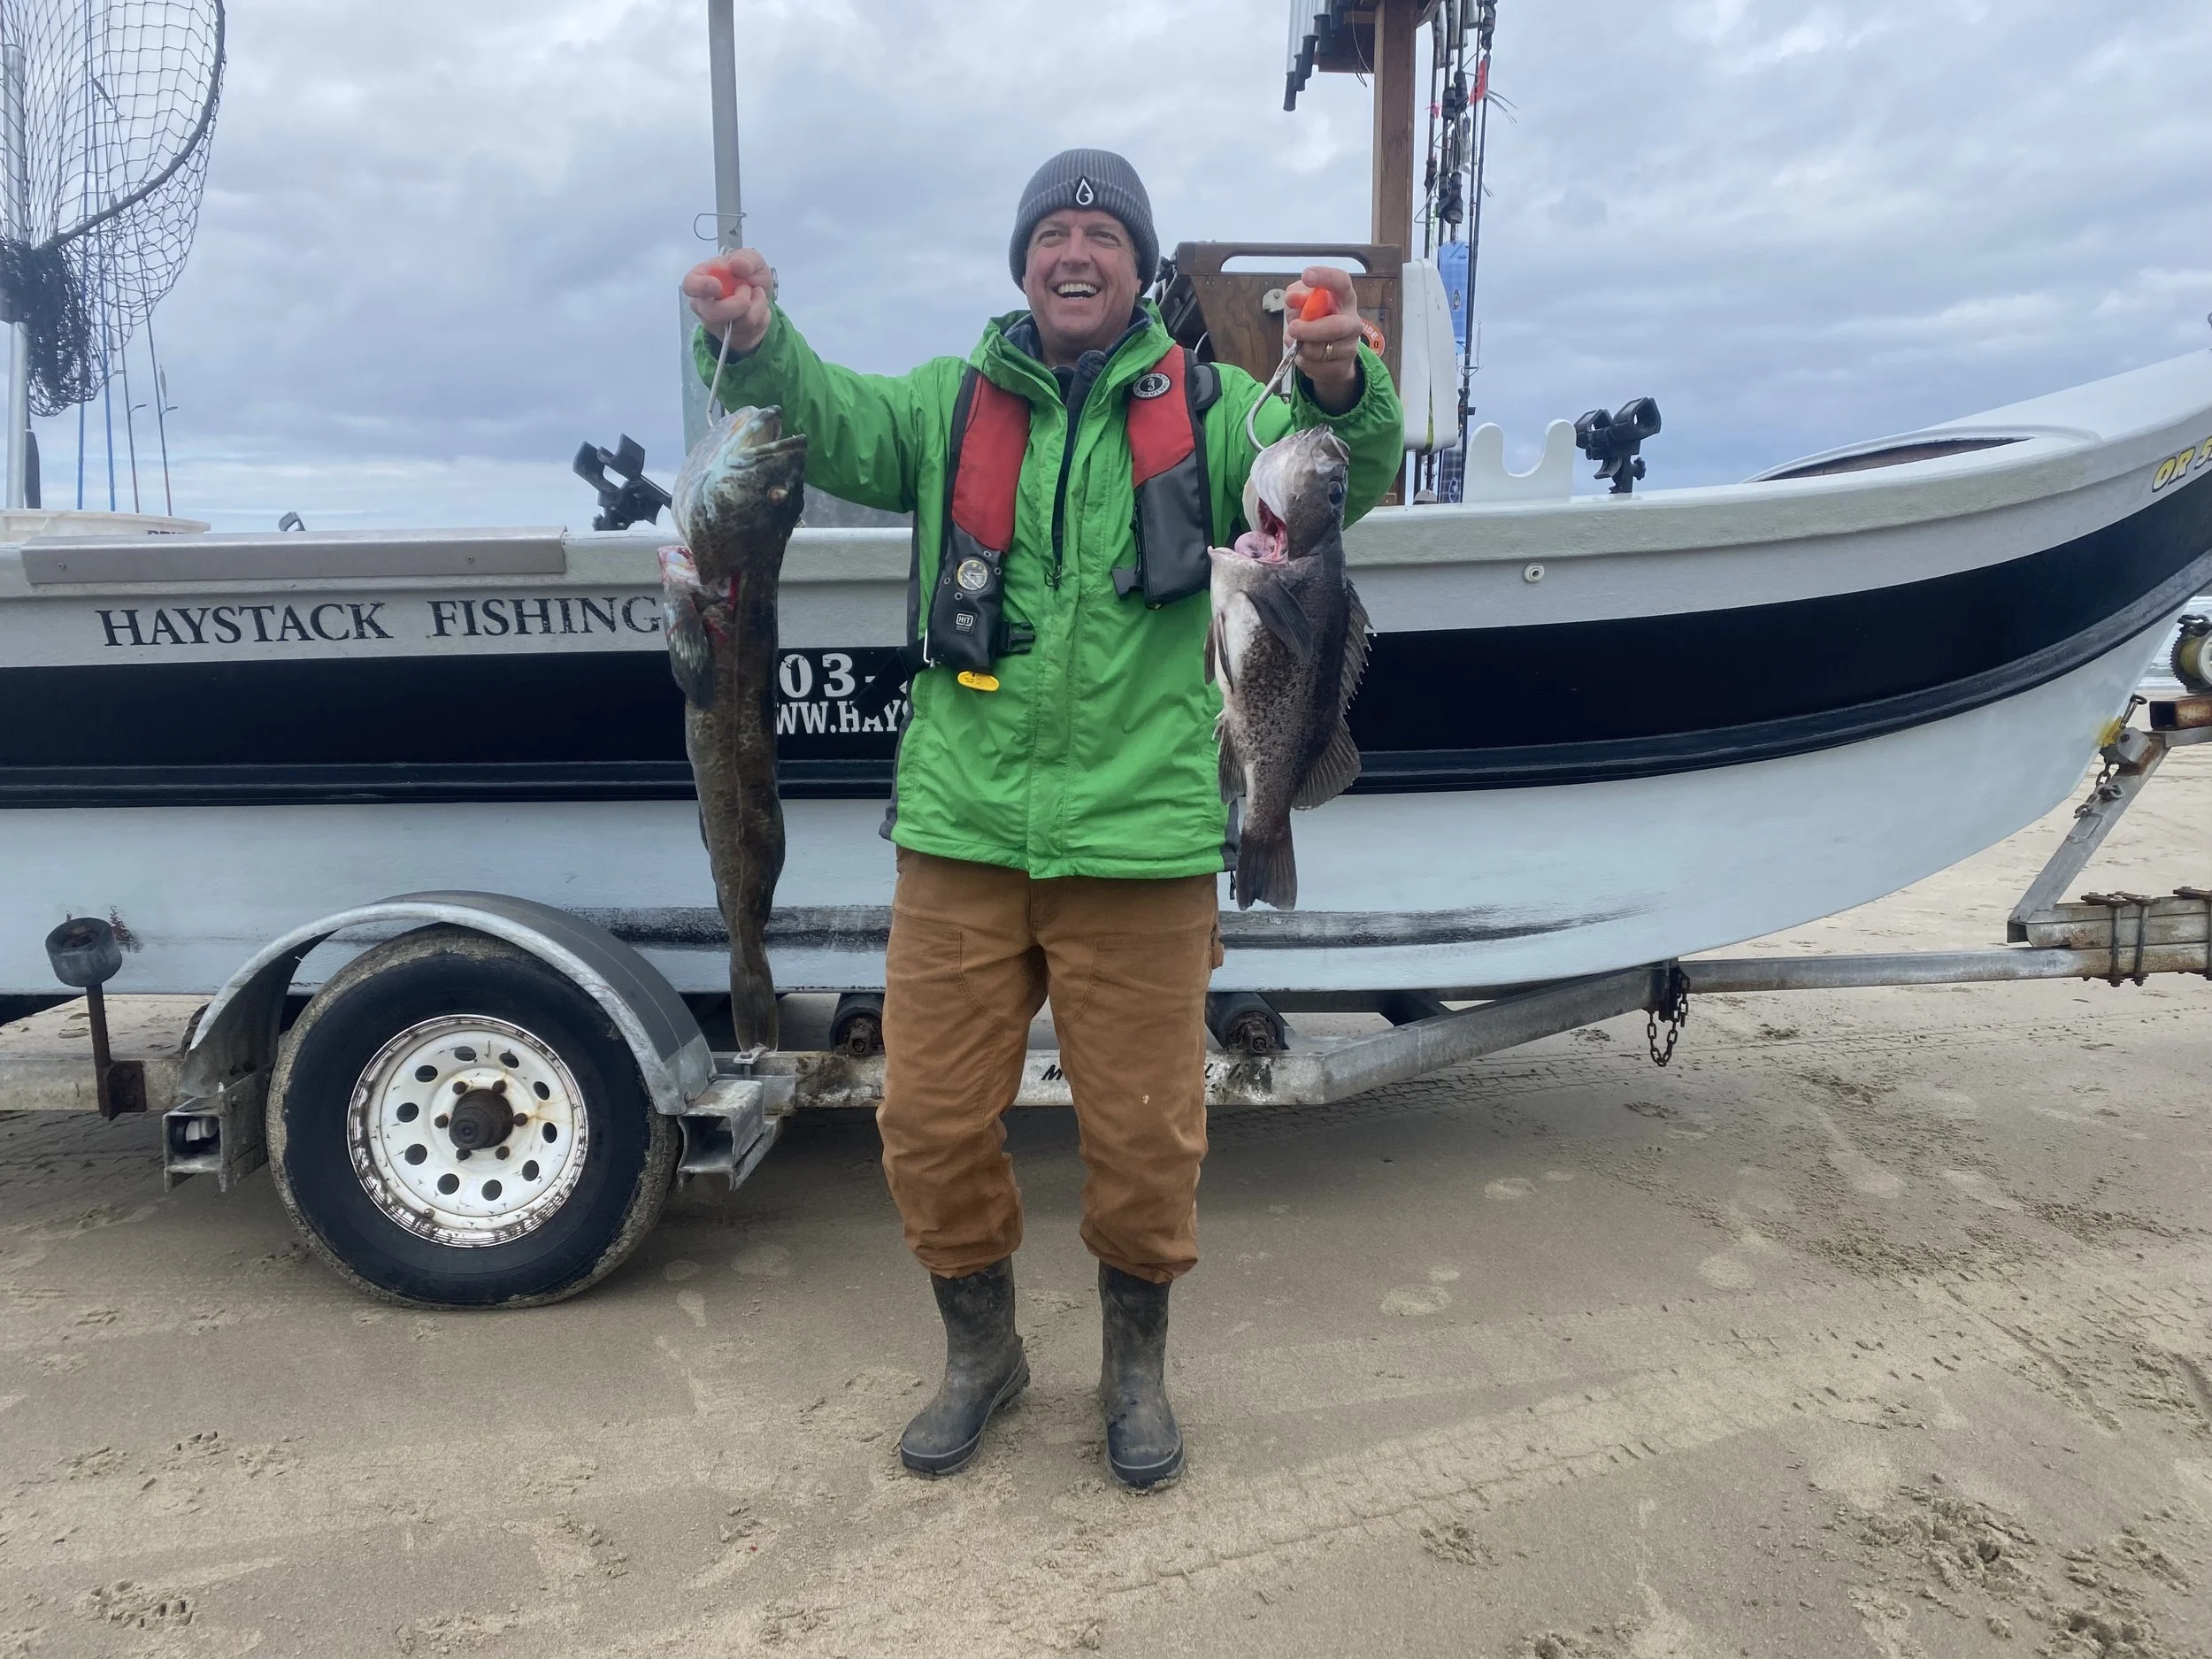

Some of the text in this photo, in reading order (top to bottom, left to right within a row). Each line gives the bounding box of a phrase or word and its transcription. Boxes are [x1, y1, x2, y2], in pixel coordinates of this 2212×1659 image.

[2152, 446, 2196, 493] OR
[95, 595, 662, 647] HAYSTACK FISHING
[776, 699, 909, 735] WW.HAY
